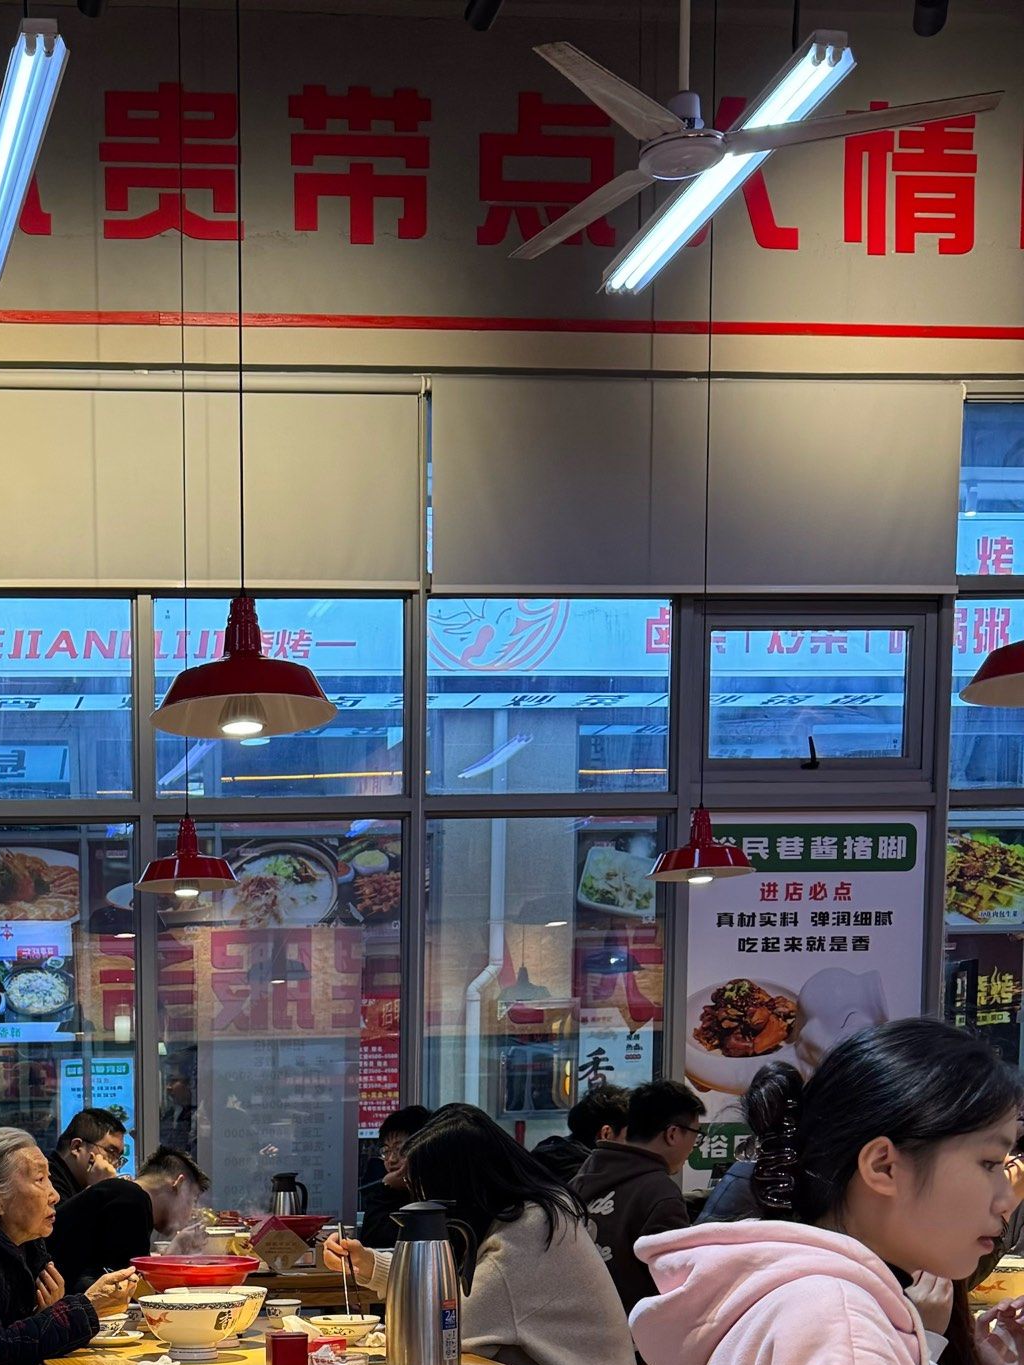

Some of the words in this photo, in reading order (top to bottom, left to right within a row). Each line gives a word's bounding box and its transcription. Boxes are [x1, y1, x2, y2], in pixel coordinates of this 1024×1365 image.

[713, 835, 907, 861] 民巷酱猪脚
[759, 882, 853, 902] 进店必点
[716, 911, 799, 928] 真材实料
[810, 911, 894, 927] 弹润细腻
[737, 935, 871, 953] 吃起来就是香
